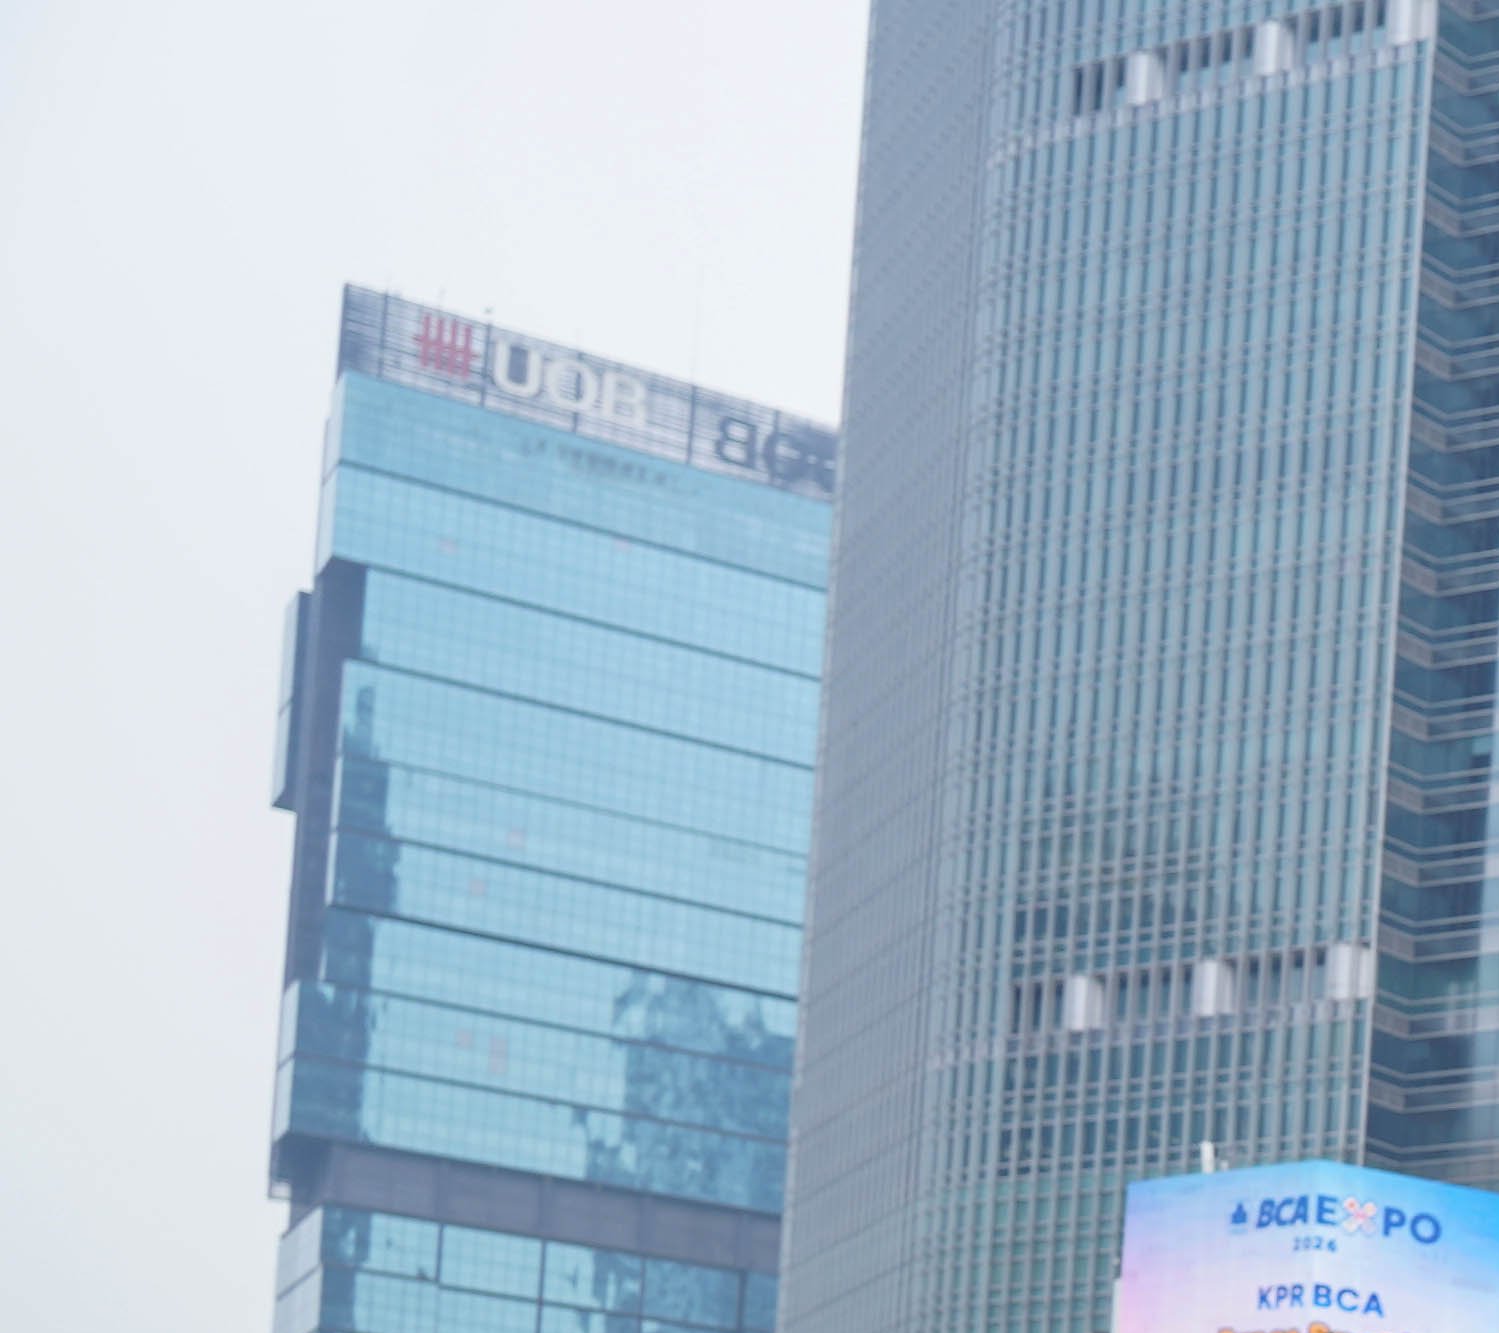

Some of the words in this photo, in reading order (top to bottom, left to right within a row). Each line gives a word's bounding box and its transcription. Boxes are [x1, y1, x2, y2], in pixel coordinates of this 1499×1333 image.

[491, 337, 649, 429] UOB
[1257, 1283, 1305, 1311] KPR
[1313, 1283, 1385, 1318] BCA
